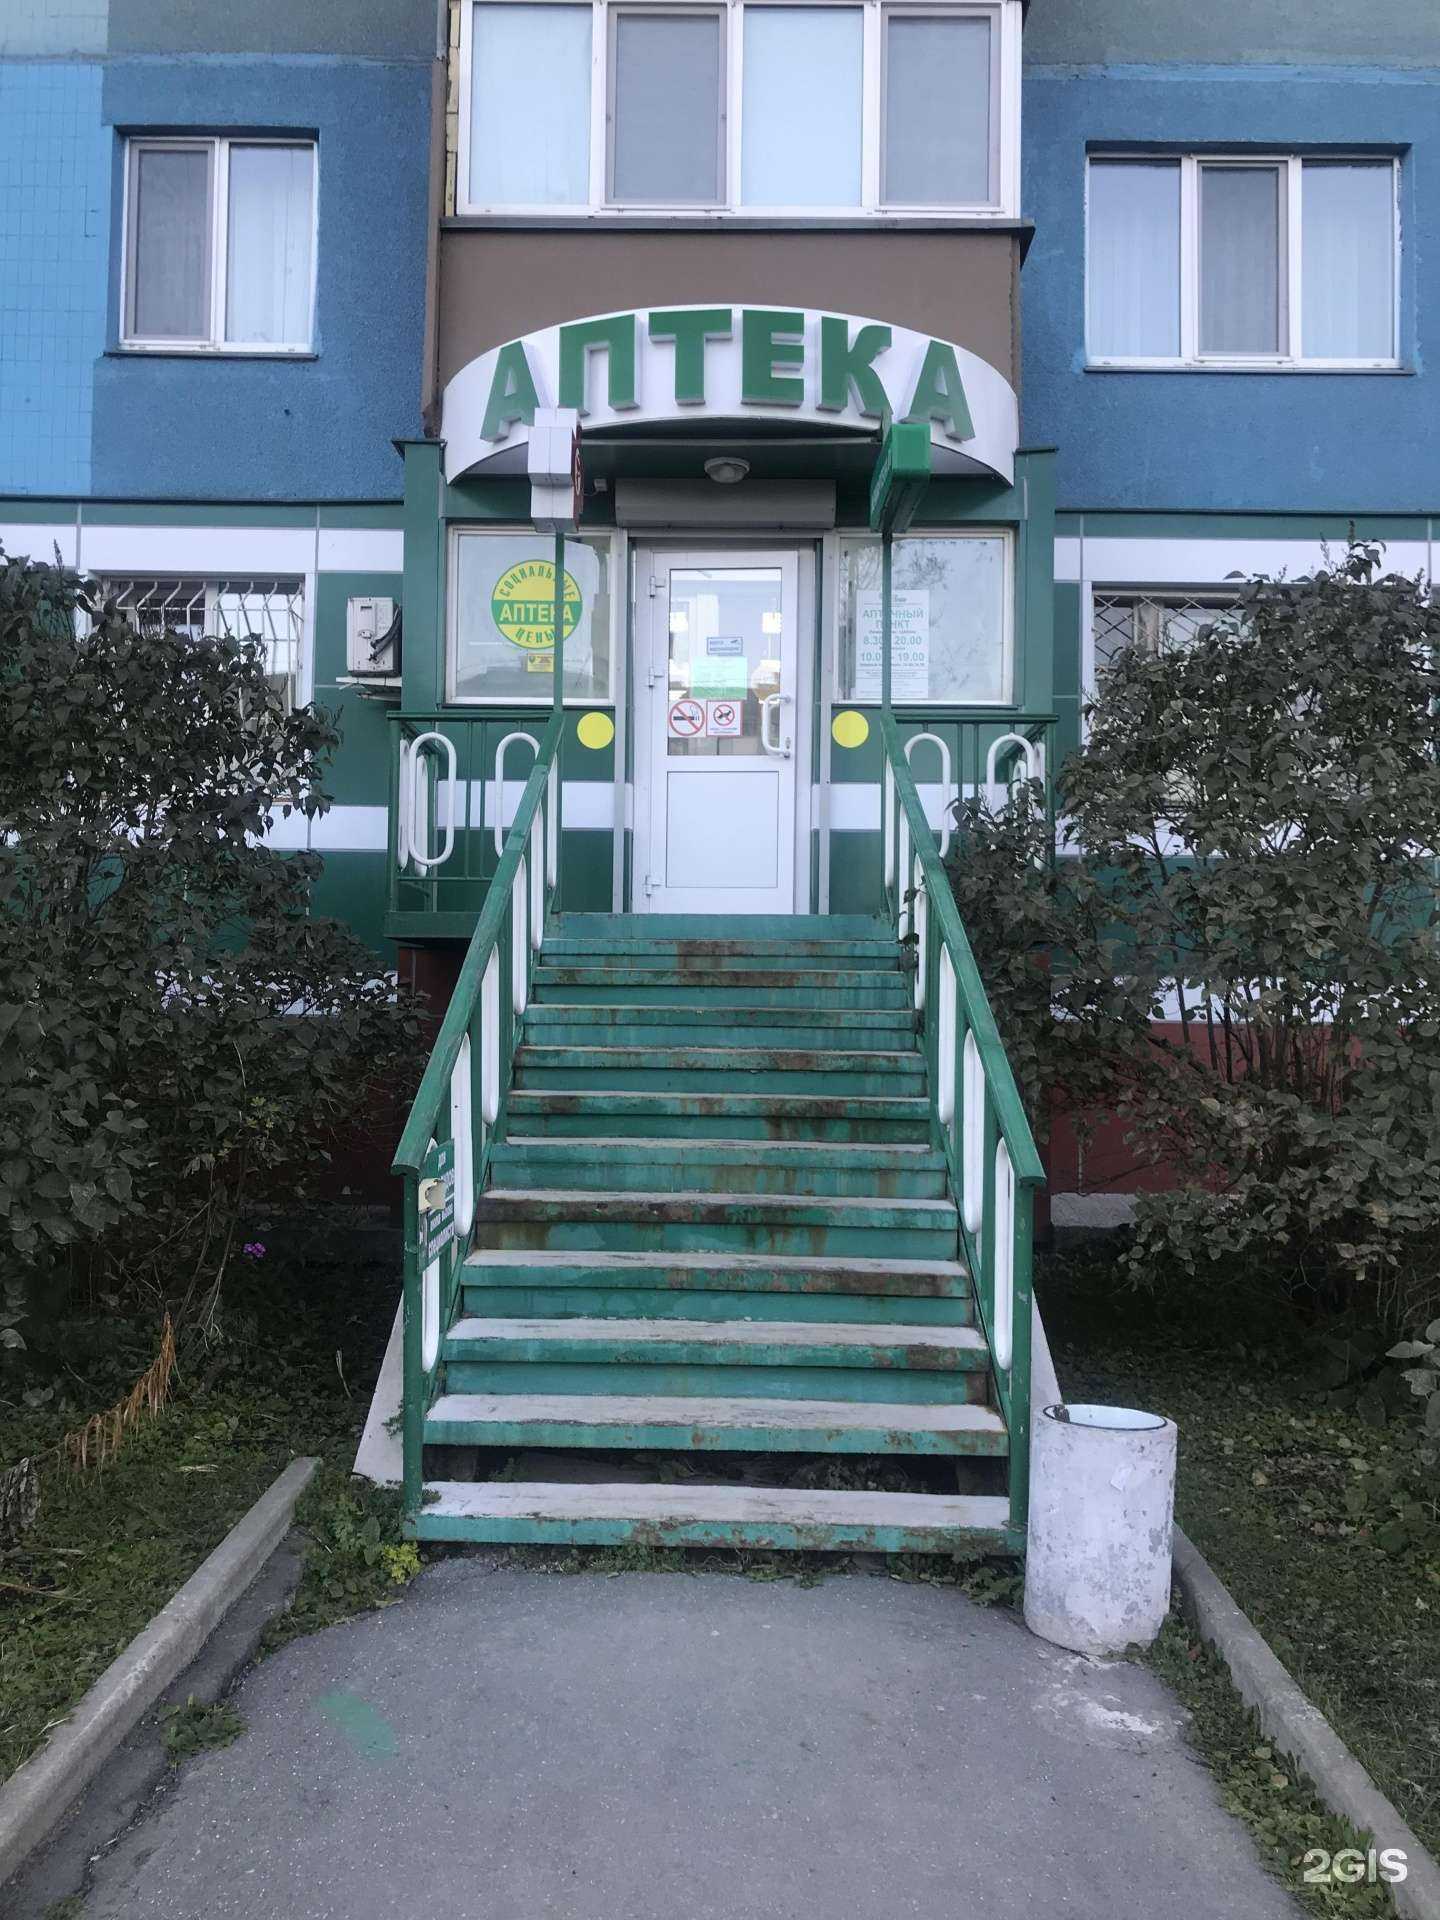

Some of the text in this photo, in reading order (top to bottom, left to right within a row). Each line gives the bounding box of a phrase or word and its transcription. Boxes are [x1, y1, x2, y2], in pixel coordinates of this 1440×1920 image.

[479, 308, 975, 442] АПТЕКА
[875, 620, 910, 630] ПНКТ
[895, 635, 922, 645] 20.00
